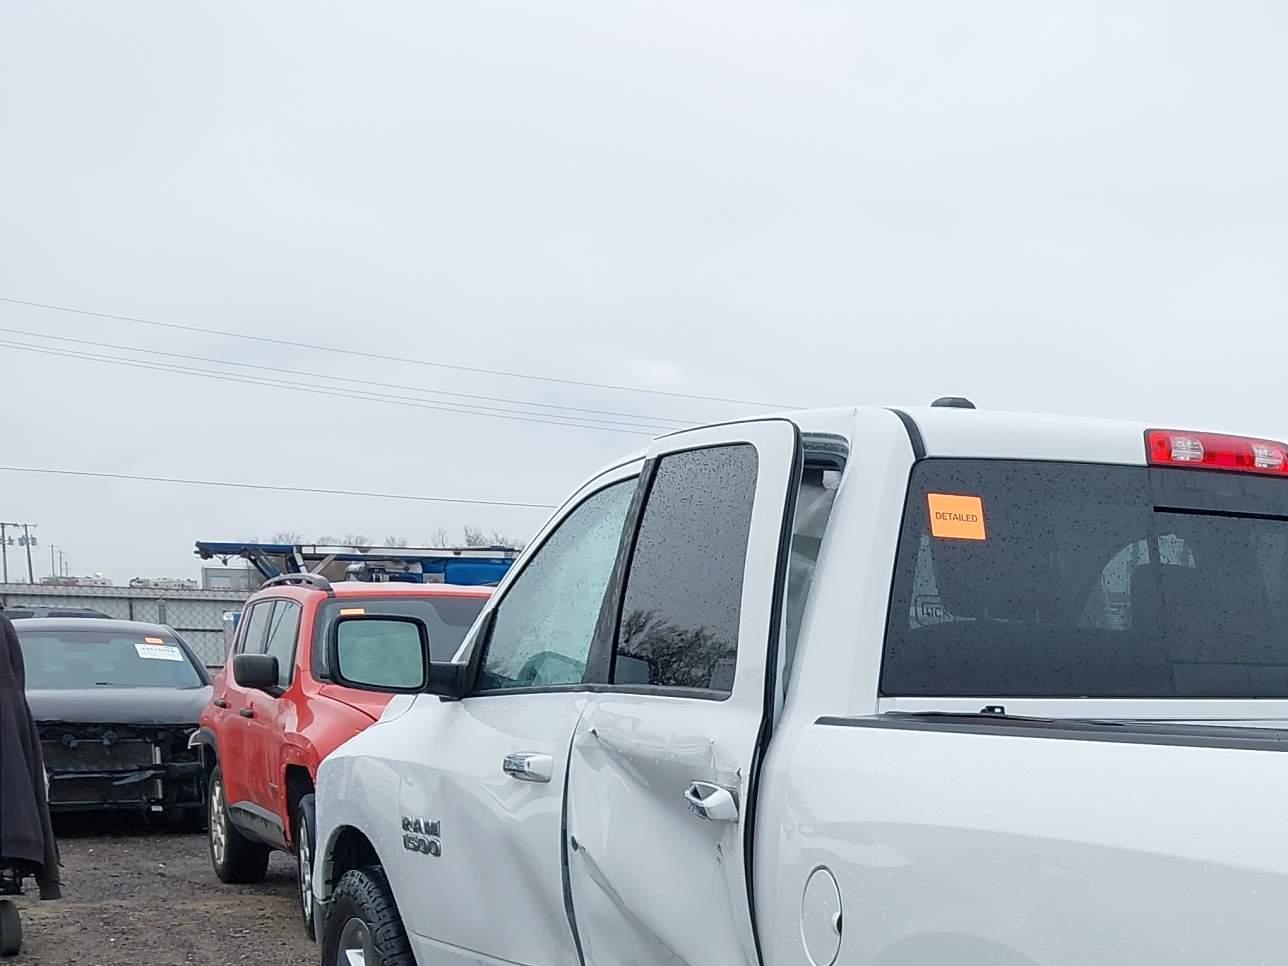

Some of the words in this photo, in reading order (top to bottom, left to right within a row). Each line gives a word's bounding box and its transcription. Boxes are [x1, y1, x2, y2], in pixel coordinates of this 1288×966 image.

[935, 511, 978, 523] DETAILED
[401, 815, 441, 838] RAM
[402, 833, 442, 857] 1500
